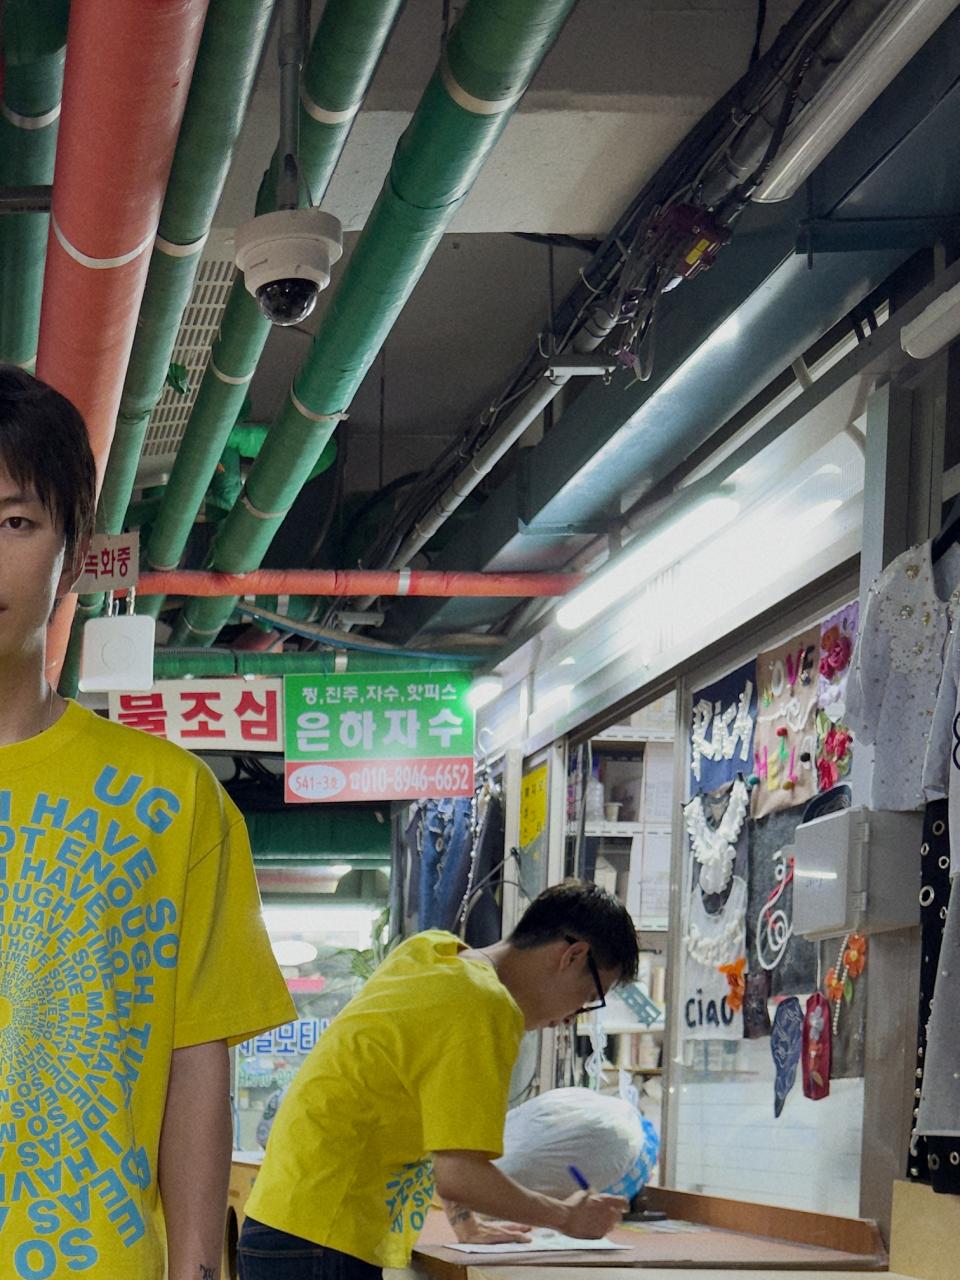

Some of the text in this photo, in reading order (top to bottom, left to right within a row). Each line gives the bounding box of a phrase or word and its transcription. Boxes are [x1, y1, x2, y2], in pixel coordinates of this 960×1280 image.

[117, 688, 279, 742] 불조심
[296, 708, 464, 752] 은하자수
[361, 763, 469, 794] 010-8946-6652
[0, 791, 11, 822] I
[30, 792, 157, 889] HAVE
[138, 896, 180, 969] SO
[13, 902, 77, 948] HAVE
[19, 855, 112, 921] HAVE
[101, 925, 131, 977] SO
[55, 835, 156, 1004] ENOUGH
[69, 948, 99, 983] SO
[76, 990, 104, 1068] MANY
[10, 1069, 80, 1120] IDEAS
[68, 1031, 121, 1110] HAVE
[16, 1094, 118, 1168] IDEAS
[26, 1105, 68, 1137] SO
[100, 1131, 122, 1155] I
[27, 1146, 152, 1235] DEAS
